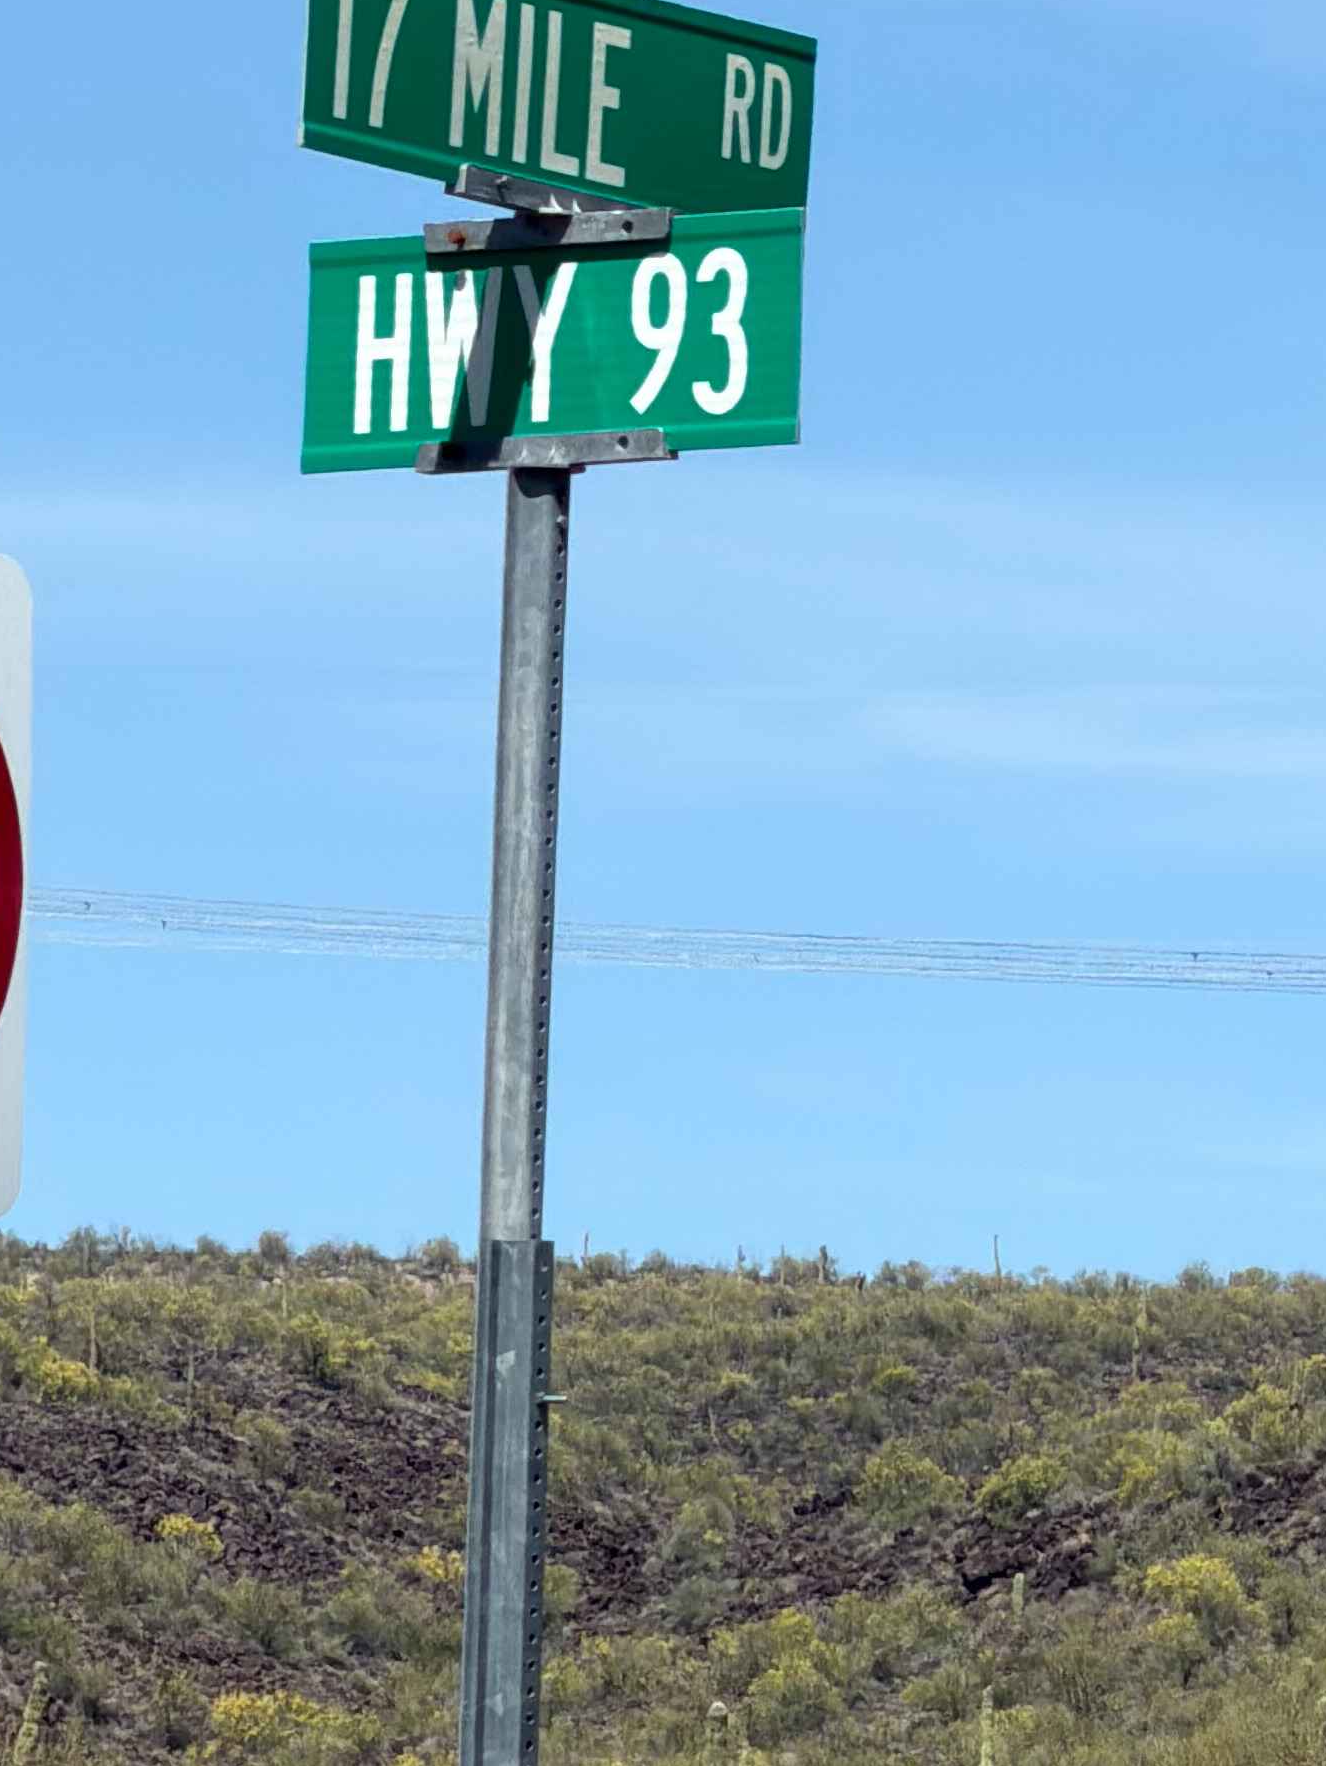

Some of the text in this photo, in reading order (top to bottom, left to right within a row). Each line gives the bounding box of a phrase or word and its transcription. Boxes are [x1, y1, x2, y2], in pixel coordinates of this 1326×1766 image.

[721, 53, 793, 171] RD
[353, 246, 749, 435] HWY 93
